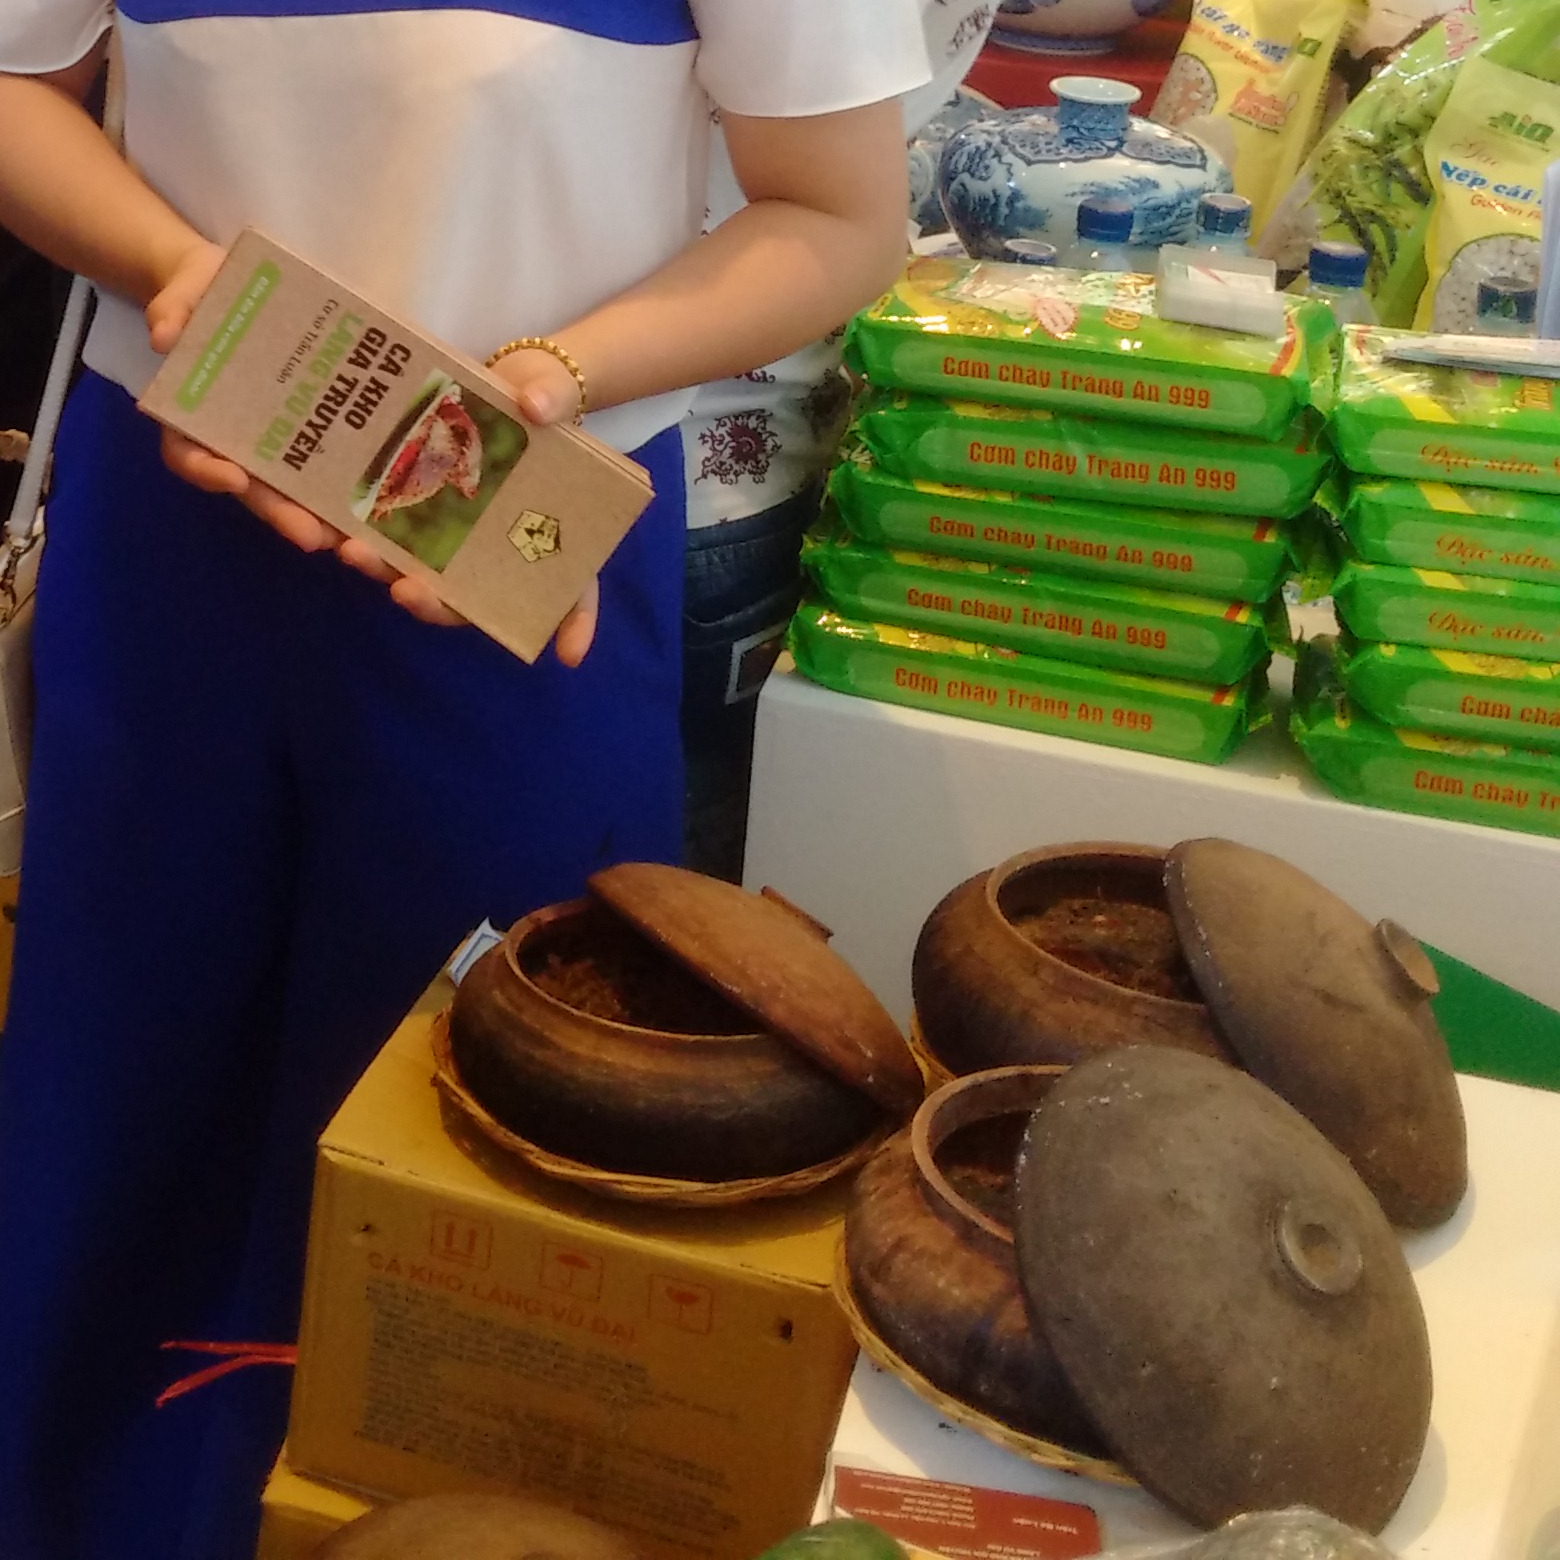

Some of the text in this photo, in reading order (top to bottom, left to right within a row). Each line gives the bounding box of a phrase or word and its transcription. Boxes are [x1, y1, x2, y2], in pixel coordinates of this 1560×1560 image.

[282, 326, 388, 471] GIA TRUYỀN
[344, 376, 392, 430] KHO
[1132, 379, 1159, 403] An
[1168, 385, 1210, 409] 999
[1159, 463, 1186, 486] An
[1195, 468, 1236, 491] 999
[1116, 545, 1143, 565] An
[1152, 550, 1193, 572] 999
[1091, 619, 1117, 640] An
[1126, 625, 1167, 650] 999
[1077, 701, 1103, 724] An
[1112, 707, 1153, 732] 999
[409, 1263, 462, 1291] KHO
